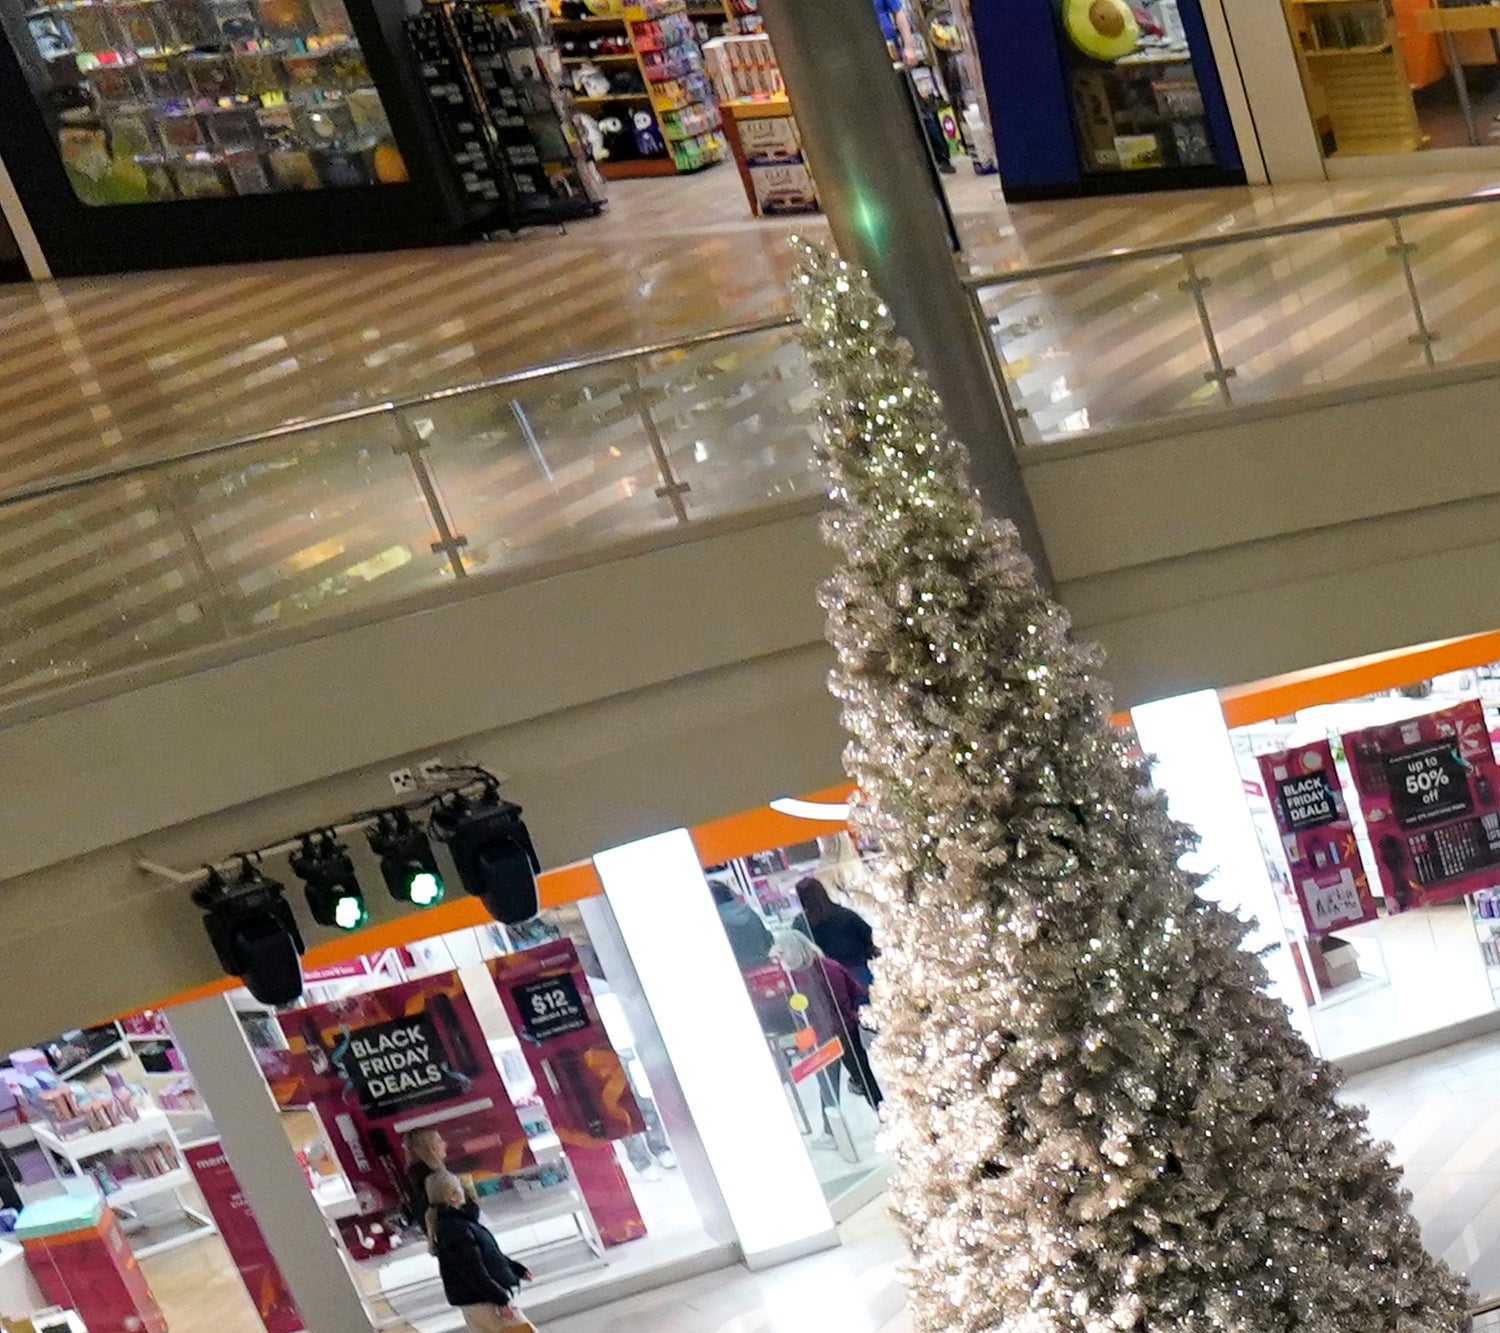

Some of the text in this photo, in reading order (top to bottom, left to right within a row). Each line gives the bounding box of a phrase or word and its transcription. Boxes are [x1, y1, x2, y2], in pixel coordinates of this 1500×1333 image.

[1407, 756, 1438, 773] up to
[1283, 776, 1323, 797] BLACK
[1405, 767, 1450, 794] 50%
[1287, 789, 1325, 809] FRIDAY
[1422, 789, 1440, 804] off
[1290, 802, 1331, 822] DEALS
[530, 988, 569, 1015] $12
[350, 1024, 426, 1059] BLACK
[358, 1044, 432, 1078] FRIDAY
[366, 1062, 444, 1101] DEALS
